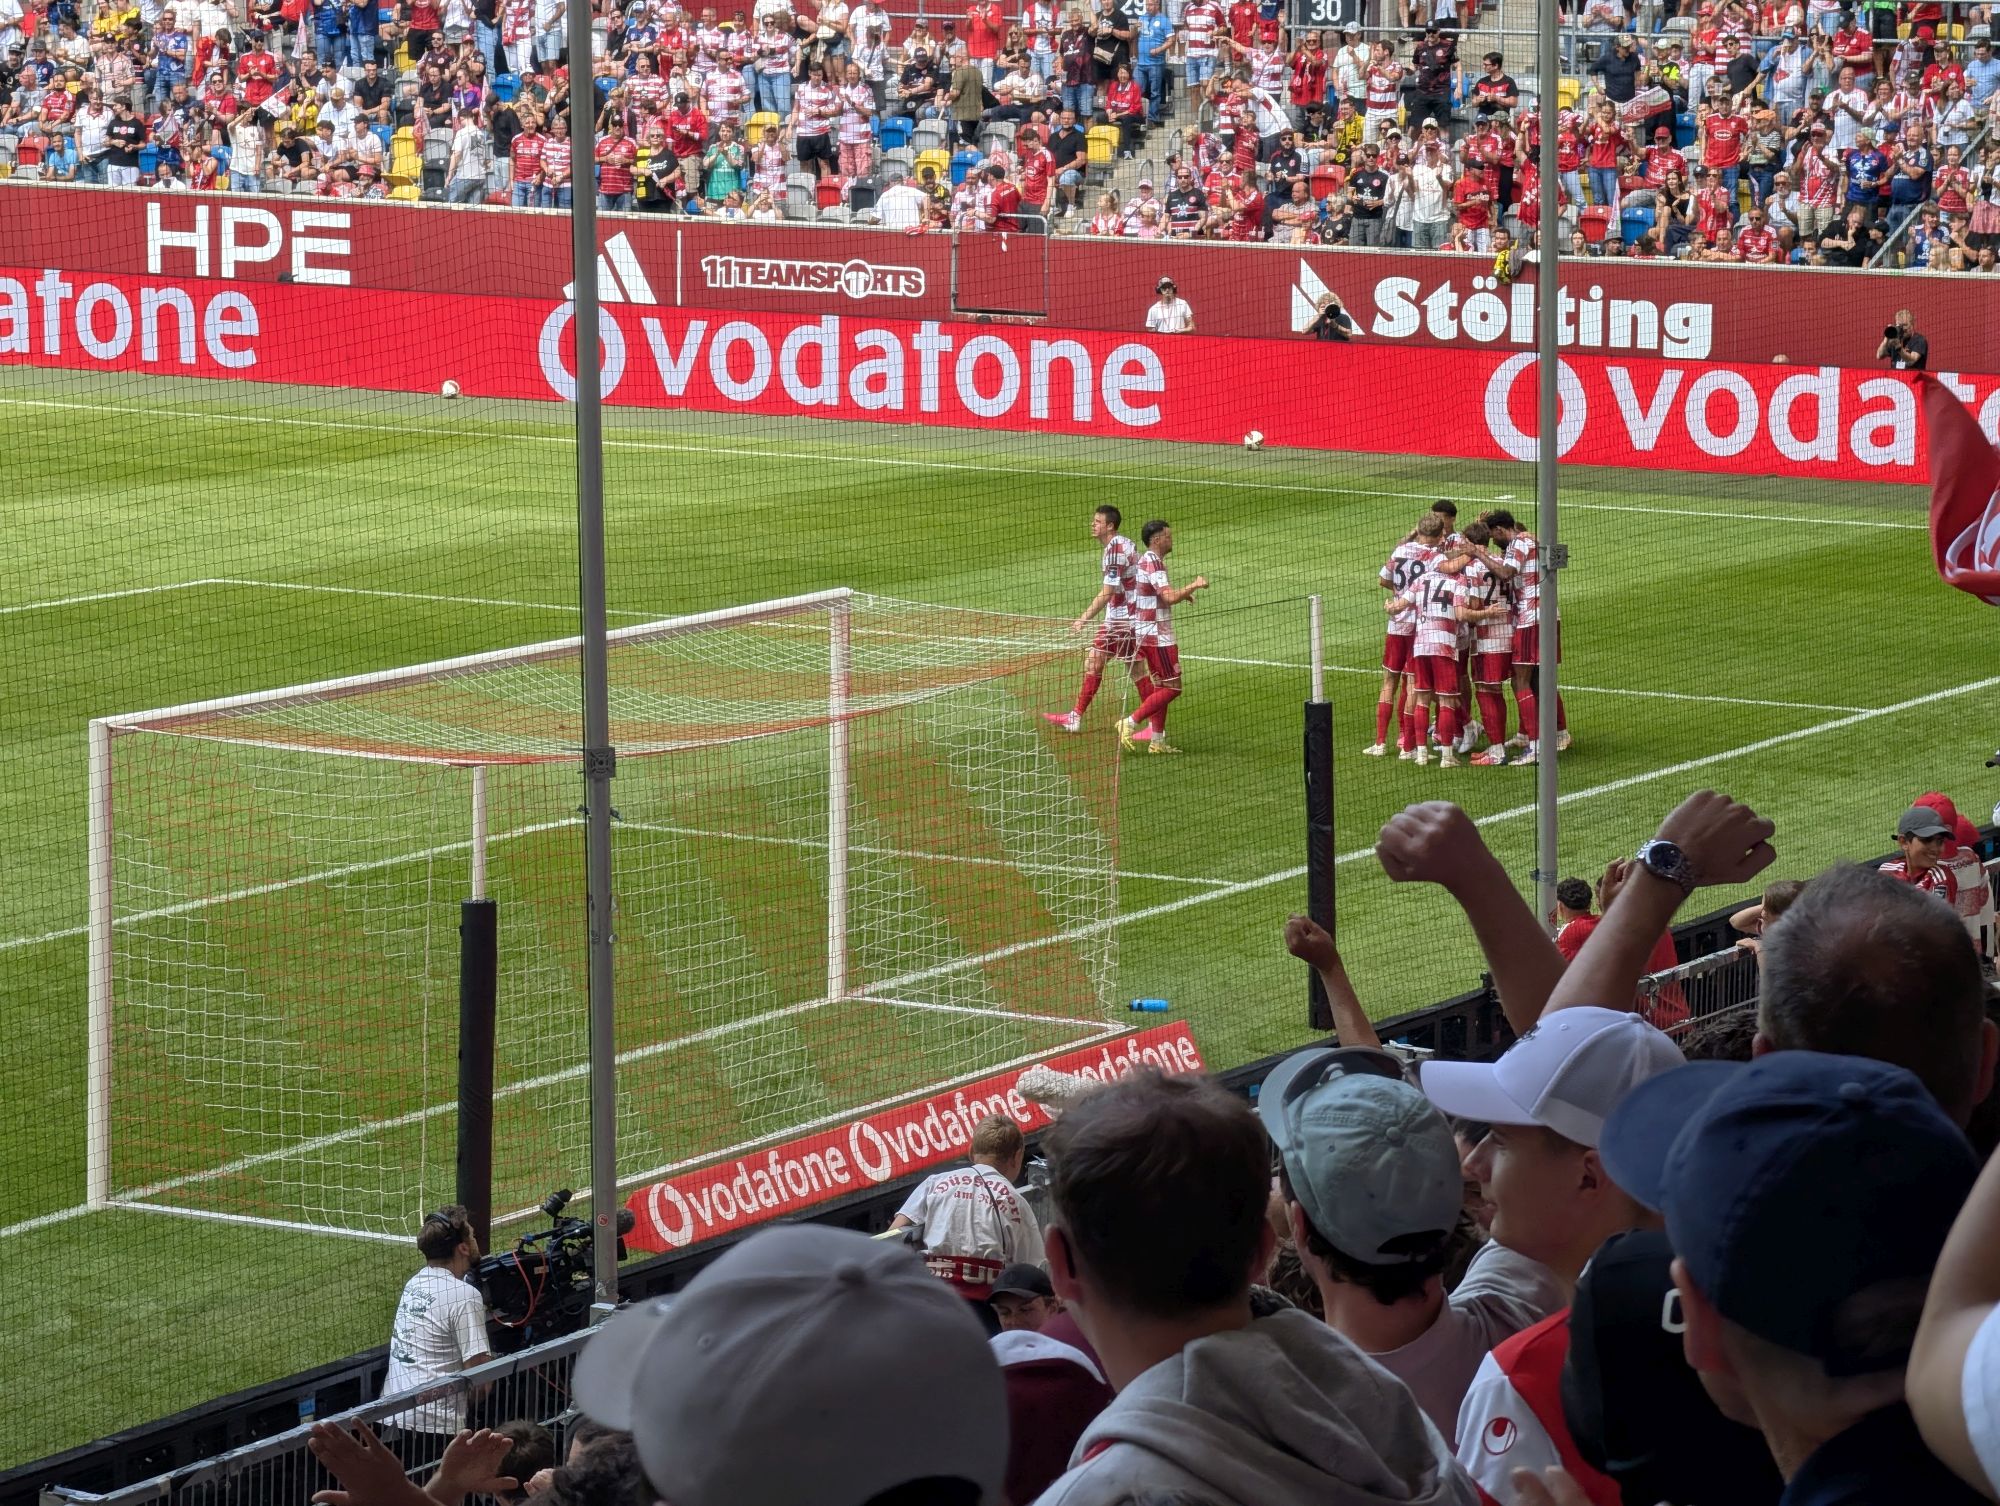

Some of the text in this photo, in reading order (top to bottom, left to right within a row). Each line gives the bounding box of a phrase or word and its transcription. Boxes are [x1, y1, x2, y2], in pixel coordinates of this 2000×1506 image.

[1310, 0, 1342, 21] 30
[147, 202, 351, 286] HPE
[1371, 275, 1714, 359] Stölting
[1606, 366, 2000, 467] voda
[1422, 580, 1455, 612] 14
[882, 1088, 1032, 1163] vodafone
[686, 1146, 851, 1227] vodafone
